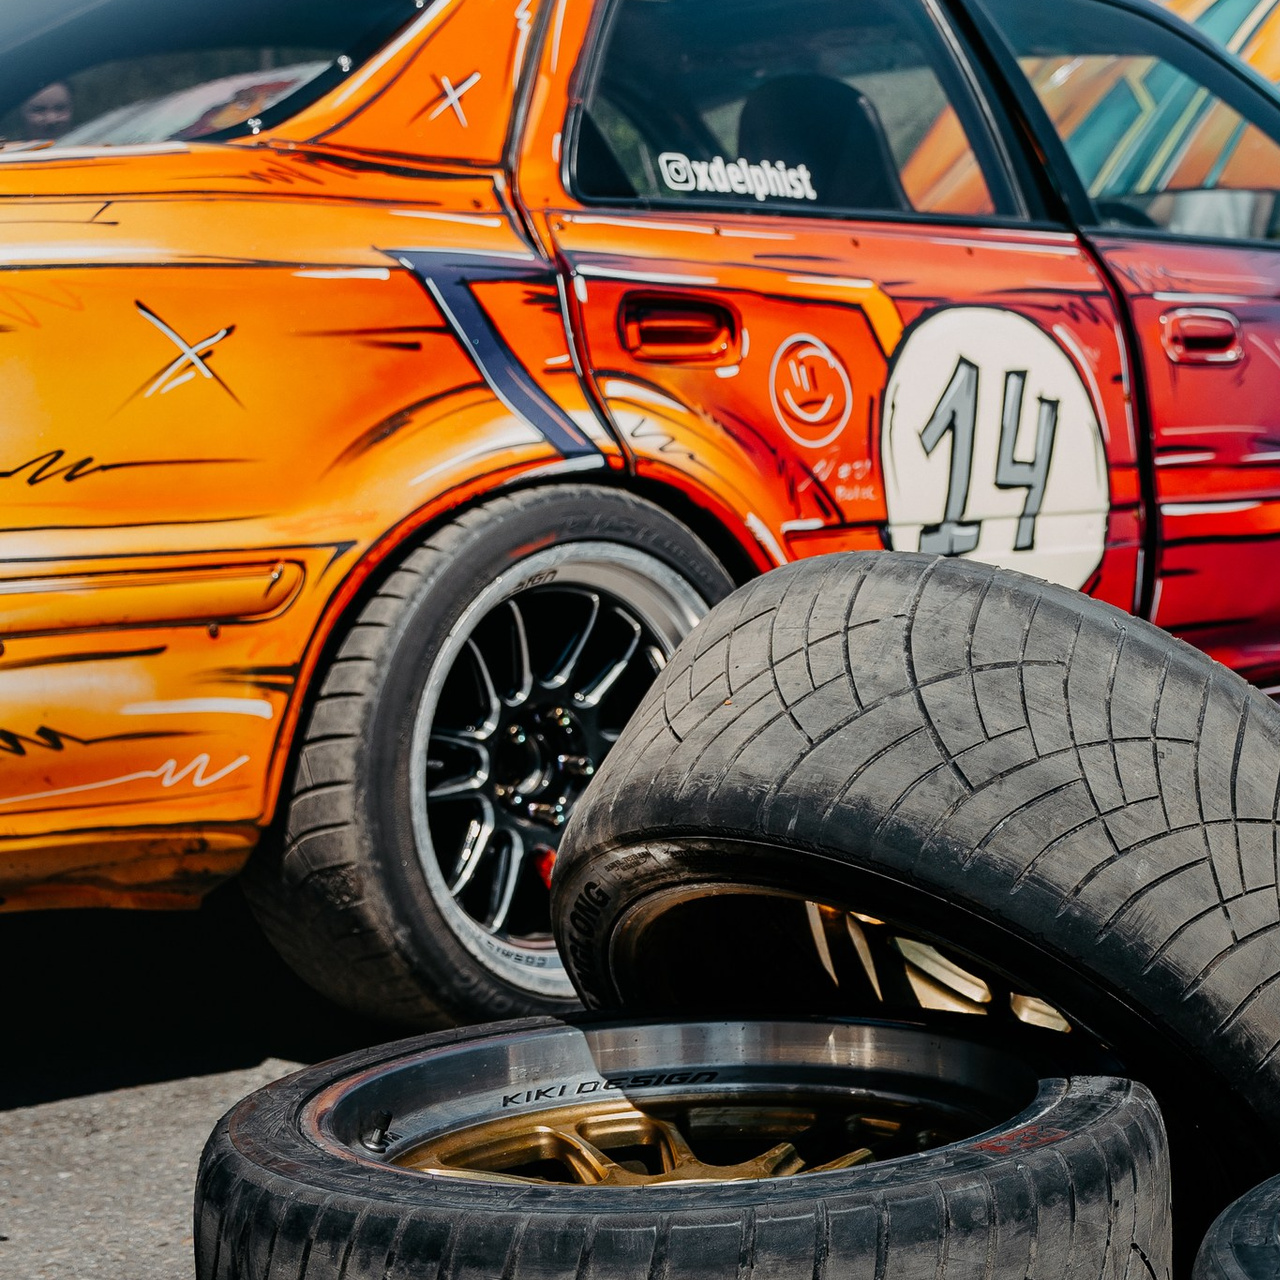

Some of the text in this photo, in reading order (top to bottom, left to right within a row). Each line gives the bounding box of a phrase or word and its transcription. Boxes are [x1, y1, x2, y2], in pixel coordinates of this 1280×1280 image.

[691, 156, 817, 201] xdelphist
[918, 355, 1059, 556] 14
[502, 1071, 719, 1107] KIKI DESIGN
